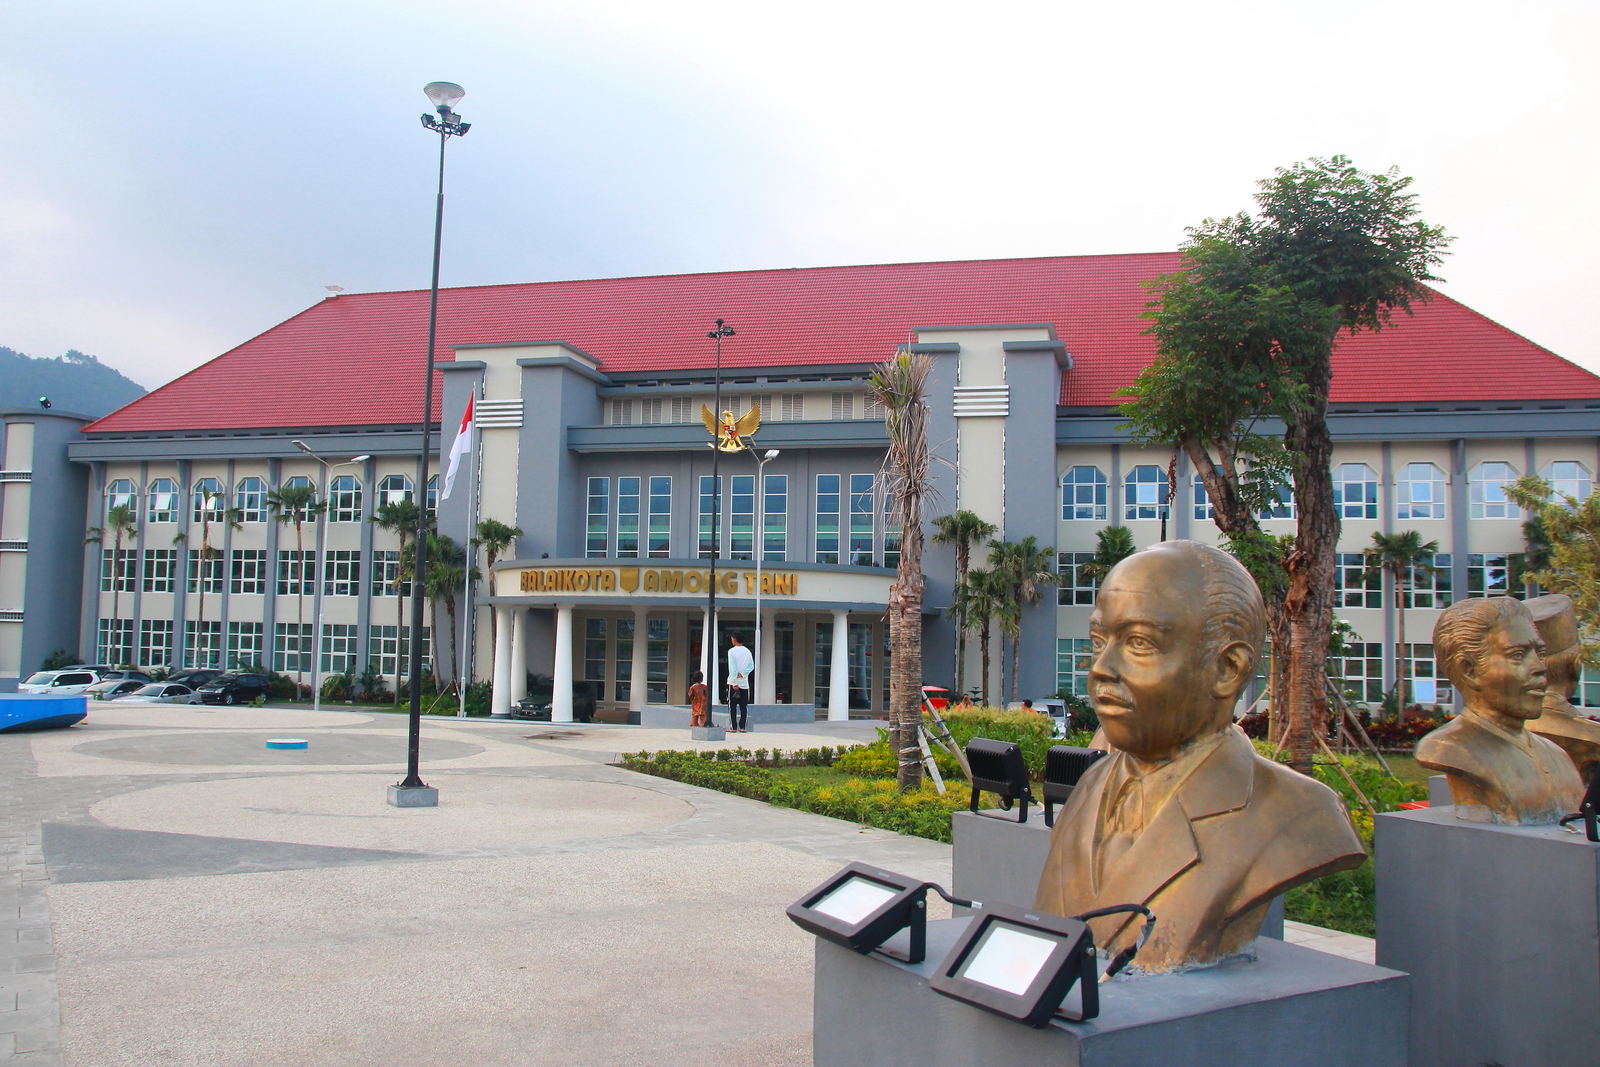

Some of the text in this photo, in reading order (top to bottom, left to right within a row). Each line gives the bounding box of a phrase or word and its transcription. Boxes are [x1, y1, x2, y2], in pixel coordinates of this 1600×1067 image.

[520, 569, 799, 595] BALAIKOTA AMONG TANI
